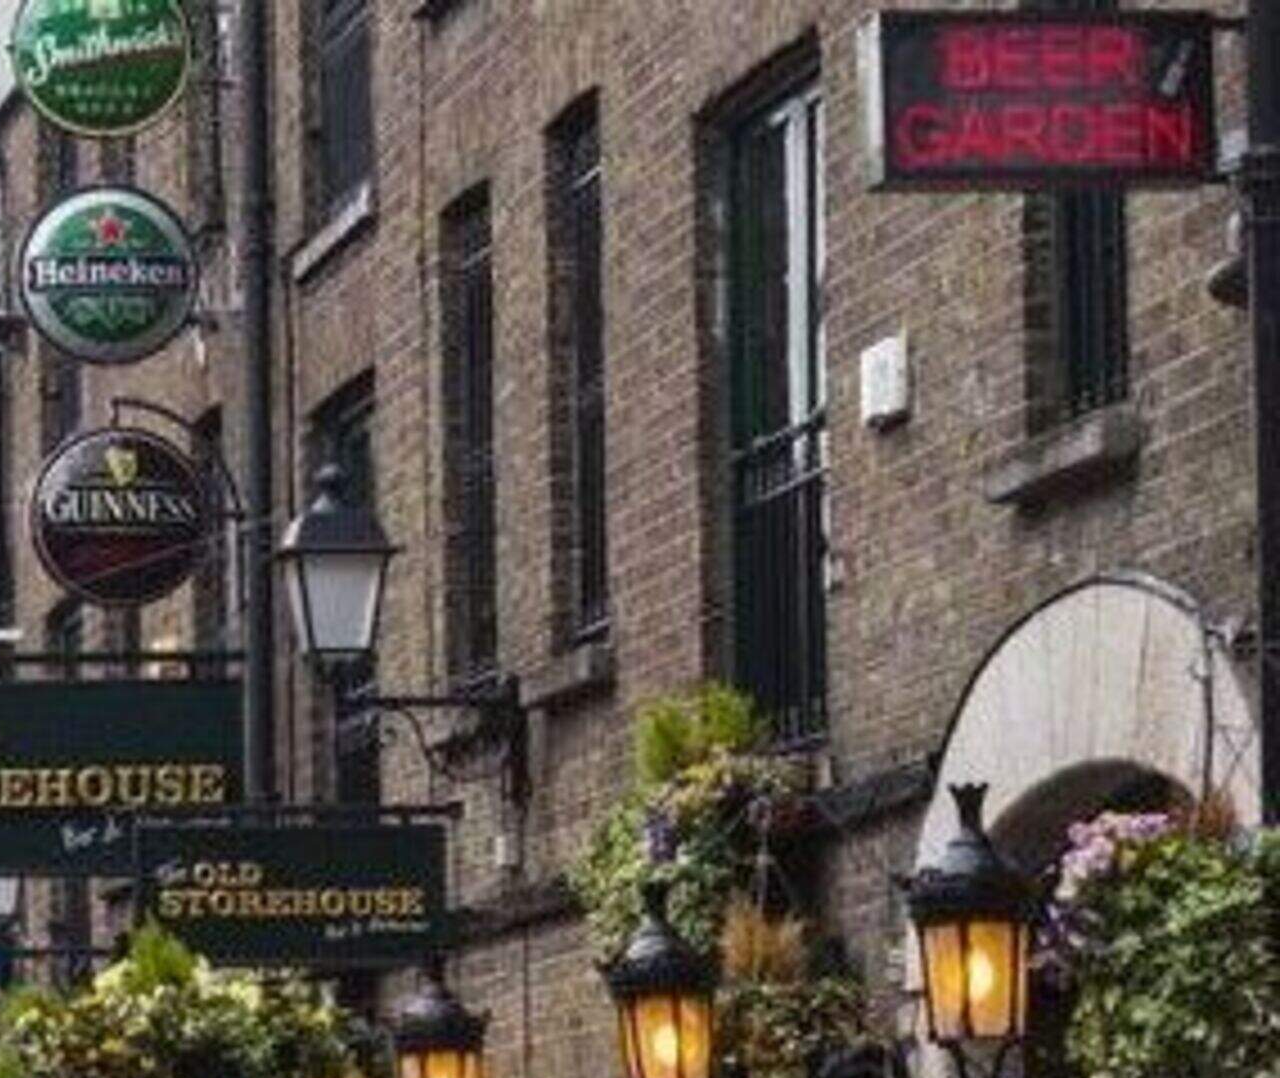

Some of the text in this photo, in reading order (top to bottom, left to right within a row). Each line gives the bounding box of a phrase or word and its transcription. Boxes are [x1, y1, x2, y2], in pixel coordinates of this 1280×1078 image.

[944, 29, 1139, 91] BEER
[893, 105, 1195, 167] GARDEN
[35, 257, 185, 288] Heineken
[46, 488, 194, 525] GUINNESS
[192, 861, 263, 886] OLD
[158, 888, 426, 918] STOREHOUSE
